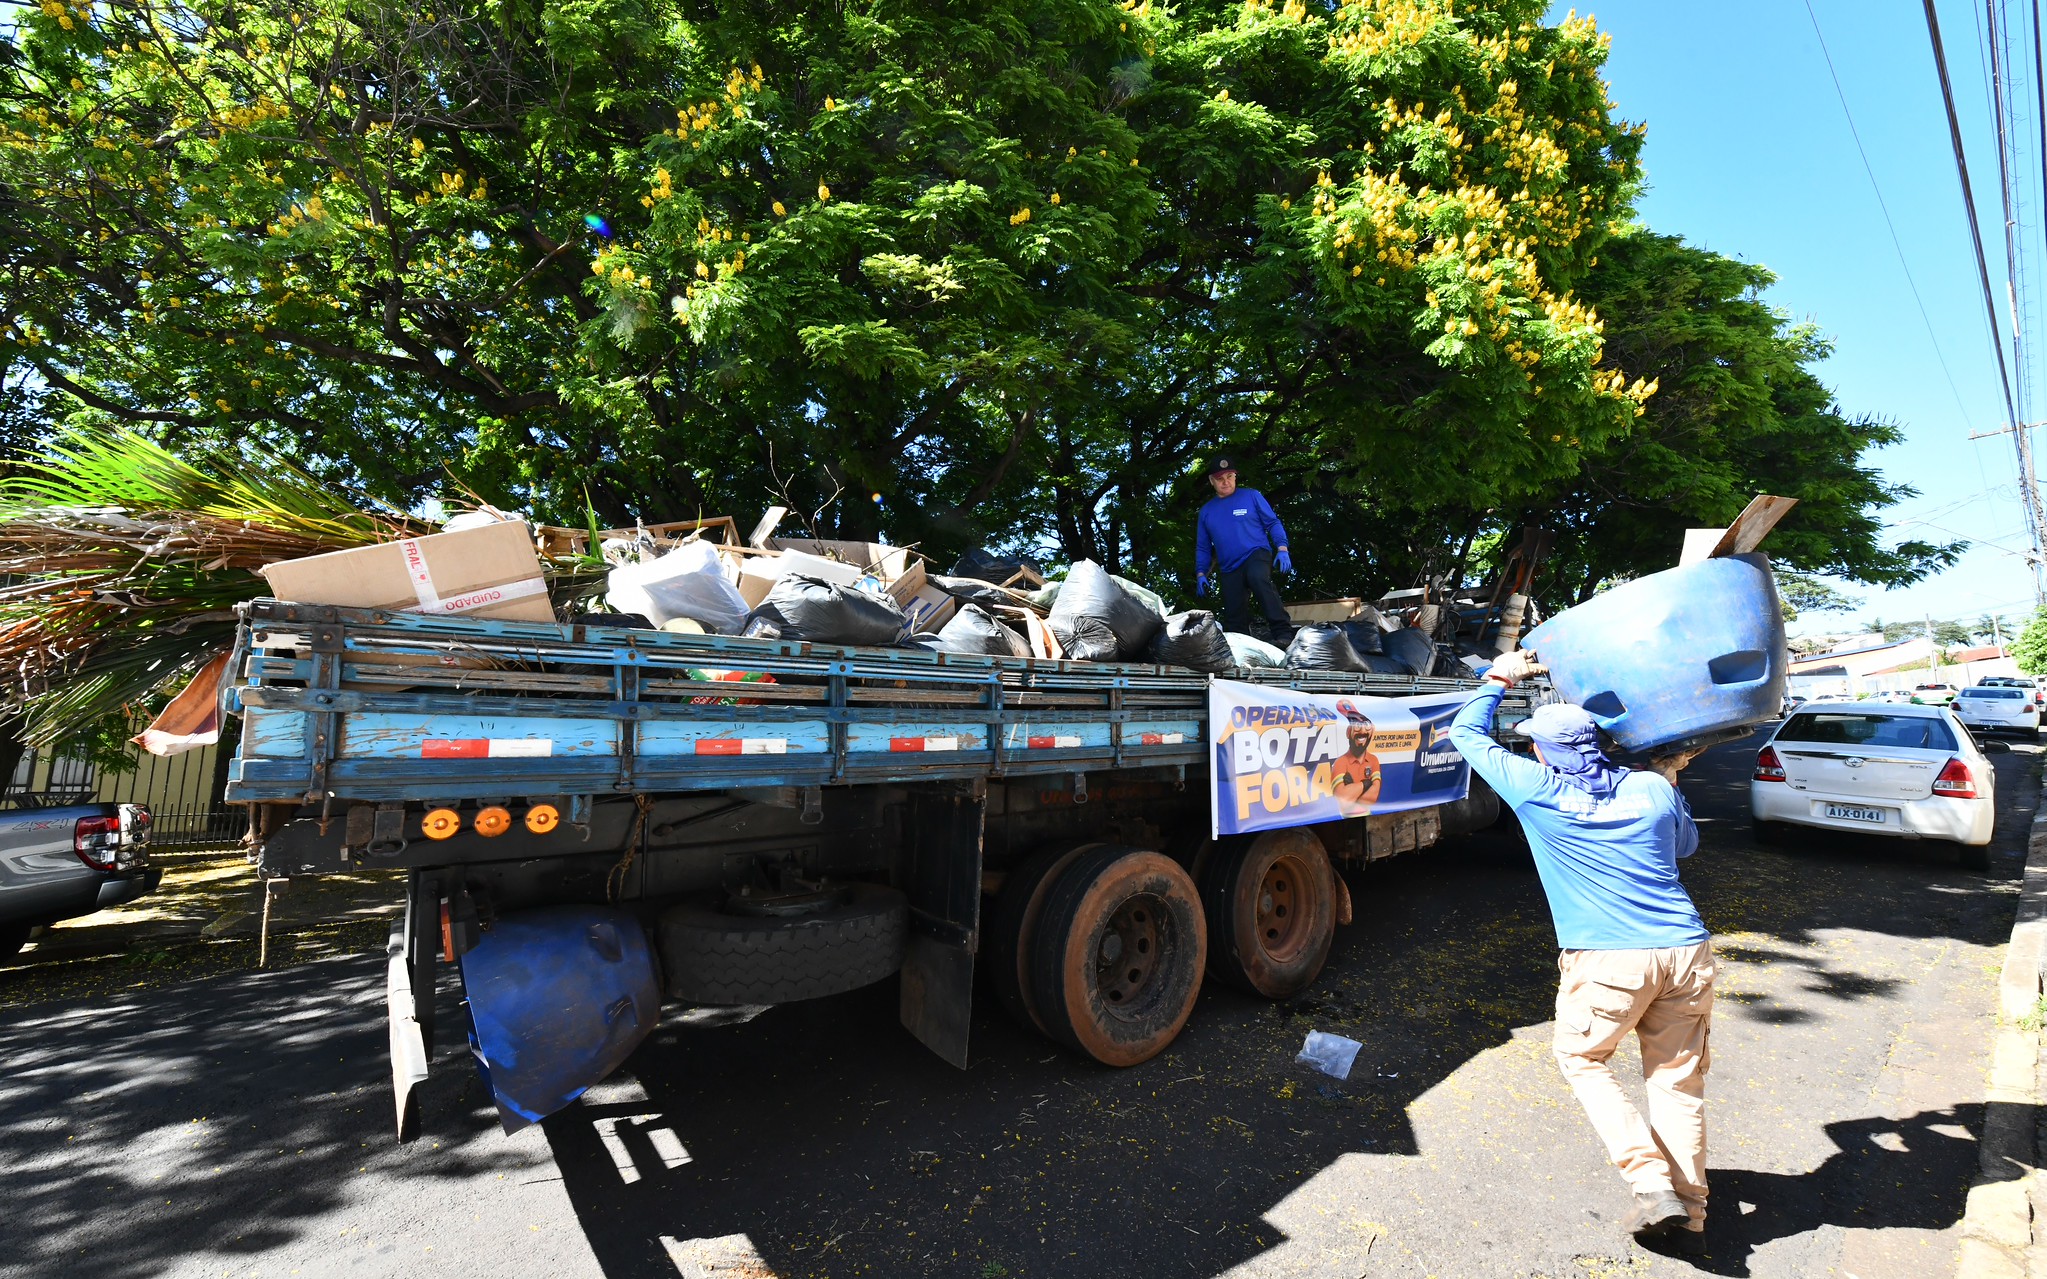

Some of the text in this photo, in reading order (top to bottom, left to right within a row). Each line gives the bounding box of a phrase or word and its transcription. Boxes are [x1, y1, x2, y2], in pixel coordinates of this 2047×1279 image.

[445, 590, 501, 611] CUIDADO
[1231, 703, 1337, 729] OPERAÇÃO
[1234, 724, 1339, 774] BOTA
[1236, 762, 1333, 820] FORA
